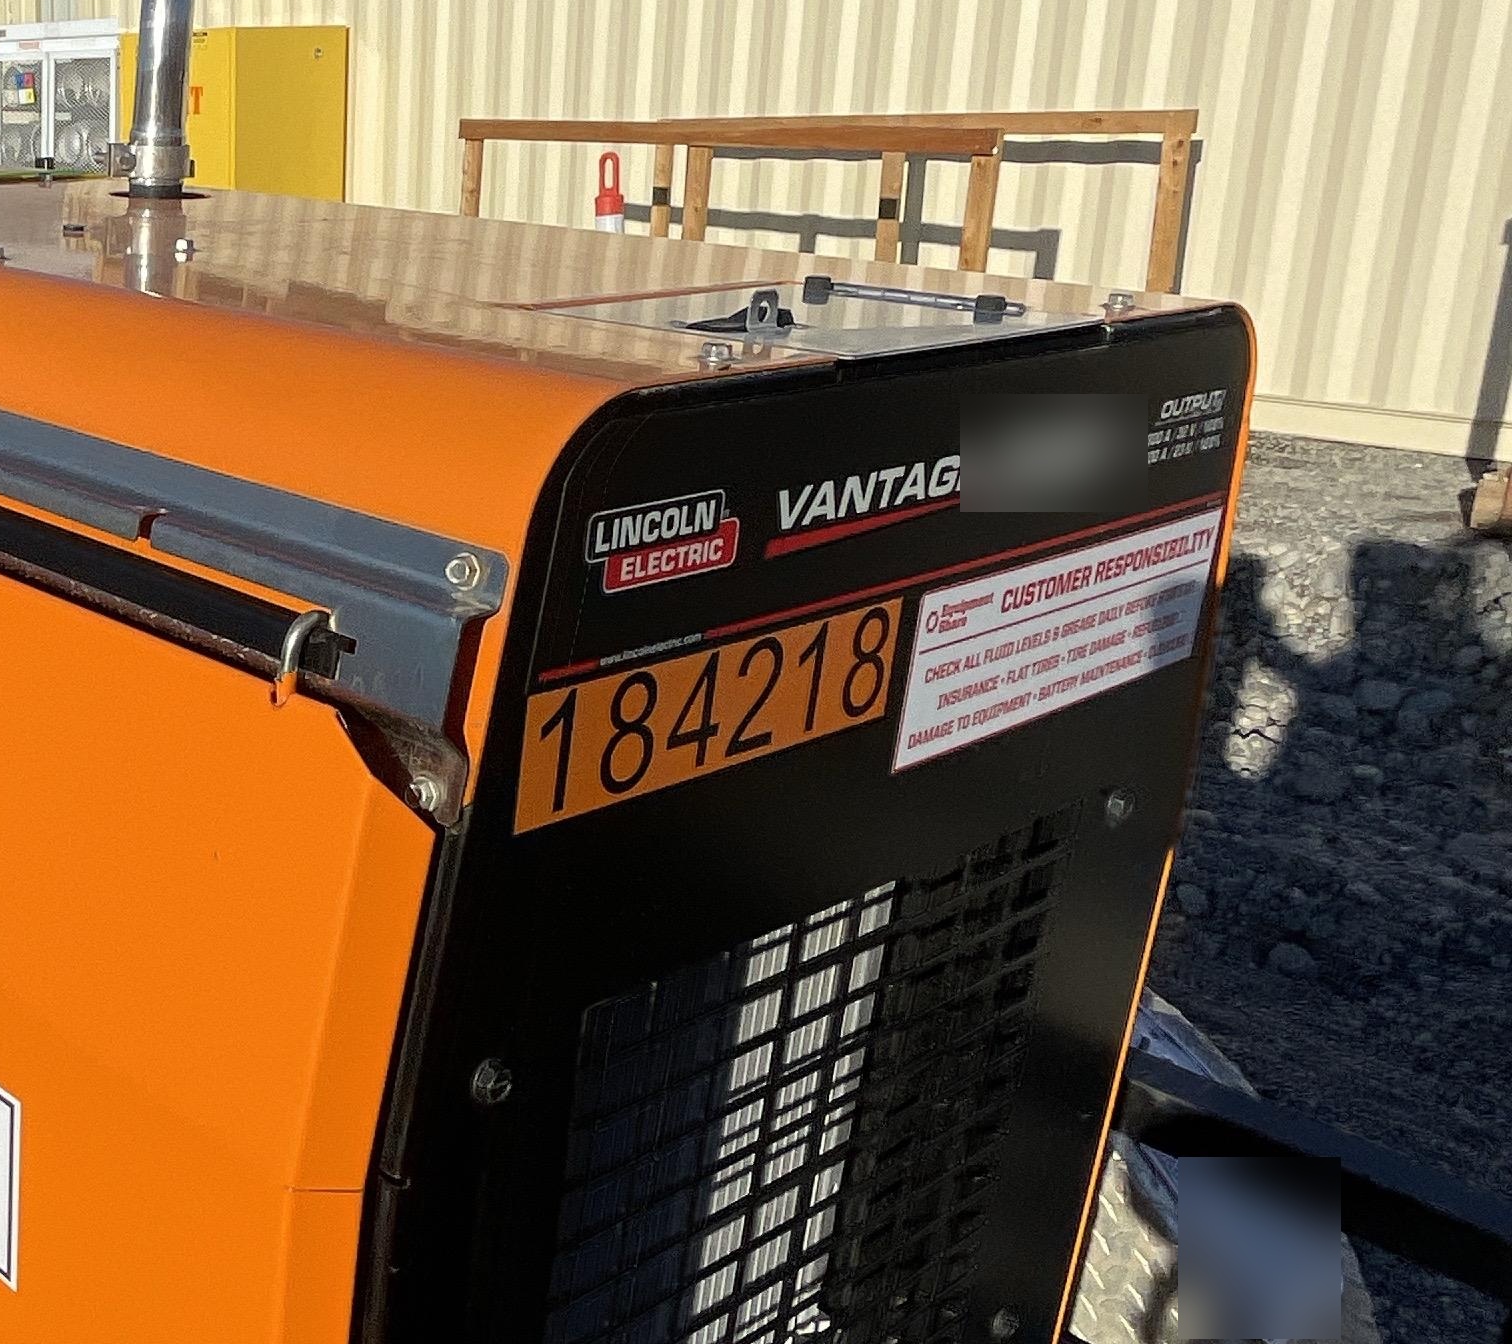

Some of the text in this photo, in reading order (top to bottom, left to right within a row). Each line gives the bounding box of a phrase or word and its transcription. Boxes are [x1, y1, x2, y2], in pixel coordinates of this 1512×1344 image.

[1160, 389, 1227, 419] OUTPUT
[778, 454, 960, 532] VANTAG
[594, 499, 717, 554] LINCOLN
[619, 537, 724, 582] ELECTRIC
[1001, 527, 1214, 612] CUSTOMER RESPONSIBILITY
[924, 658, 961, 684] CHECK
[963, 651, 982, 670] ALL
[984, 640, 1015, 663] FLUID
[1016, 628, 1052, 652] LEVELS
[1098, 604, 1124, 624] DAILY
[537, 606, 890, 813] 184218
[937, 674, 1000, 709] INSURANCE
[1006, 663, 1030, 684] FLAT
[908, 719, 954, 749] DAMAGE
[957, 713, 971, 731] TO
[972, 691, 1032, 725] EQUIPMENT
